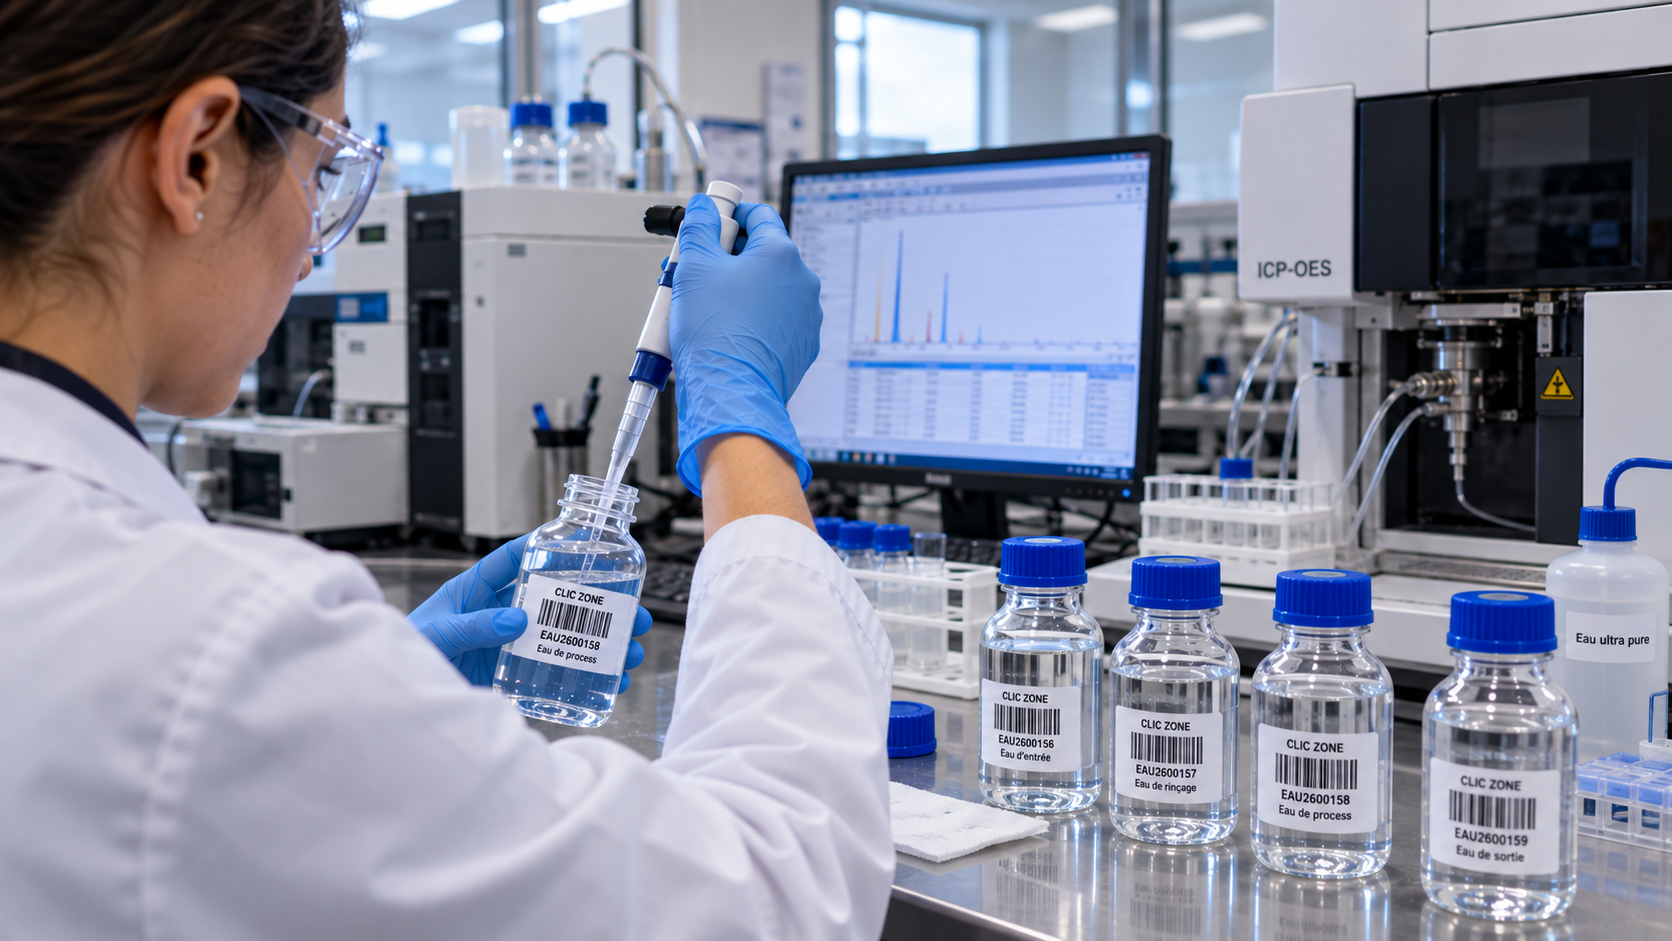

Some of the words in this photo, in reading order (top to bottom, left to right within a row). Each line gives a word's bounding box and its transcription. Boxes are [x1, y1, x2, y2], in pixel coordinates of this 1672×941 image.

[1258, 260, 1331, 278] ICP-OES
[555, 588, 576, 599] CLIC
[578, 592, 604, 605] ZONE
[540, 630, 600, 650] EAU2600158
[1576, 633, 1596, 644] Eau
[1600, 635, 1624, 645] ultra
[1628, 636, 1650, 647] pure
[537, 644, 552, 655] Eau
[554, 648, 564, 658] de
[566, 652, 597, 664] process
[1002, 691, 1021, 702] CLIC
[1023, 694, 1048, 703] ZONE
[1141, 719, 1161, 730] CLIC
[1164, 721, 1190, 731] ZONE
[999, 734, 1054, 748] EAU2600156
[1287, 739, 1310, 751] CLIC
[1313, 742, 1344, 753] ZONE
[1000, 748, 1014, 758] Eau
[1136, 764, 1197, 778] EAU2600157
[1135, 779, 1150, 788] Eau
[1152, 781, 1162, 790] de
[1165, 782, 1197, 794] rinçage
[1460, 775, 1486, 788] CLIC
[1489, 779, 1521, 791] ZONE
[1281, 789, 1350, 805] EAU2600158
[1279, 804, 1295, 816] Eau
[1298, 808, 1310, 818] de
[1313, 811, 1352, 821] process
[1455, 827, 1528, 846] EAU2600159
[1456, 845, 1475, 857] Eau
[1478, 849, 1491, 860] de
[1494, 852, 1524, 862] sortie
